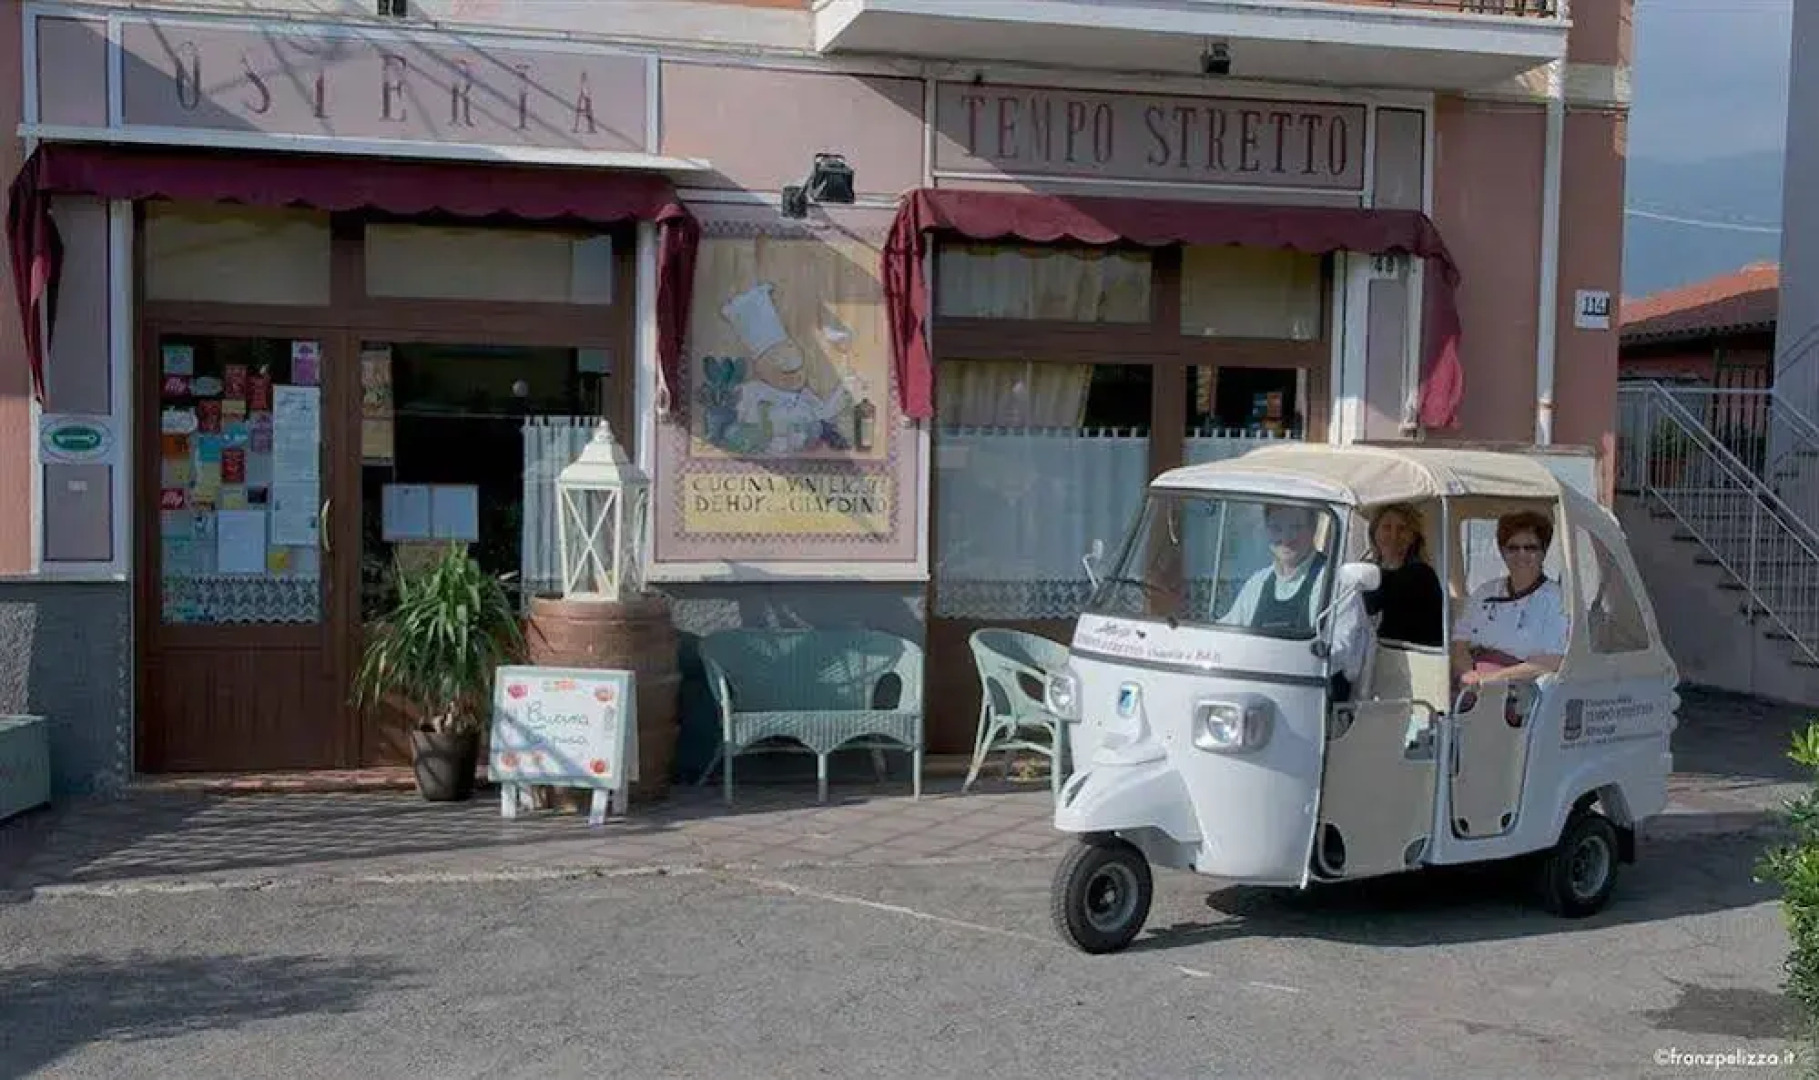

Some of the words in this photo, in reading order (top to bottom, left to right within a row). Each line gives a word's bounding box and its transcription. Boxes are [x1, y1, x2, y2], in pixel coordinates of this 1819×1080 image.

[174, 40, 598, 134] OSTERIA
[961, 94, 1114, 164] TEMPO
[1143, 104, 1350, 177] STRETTO
